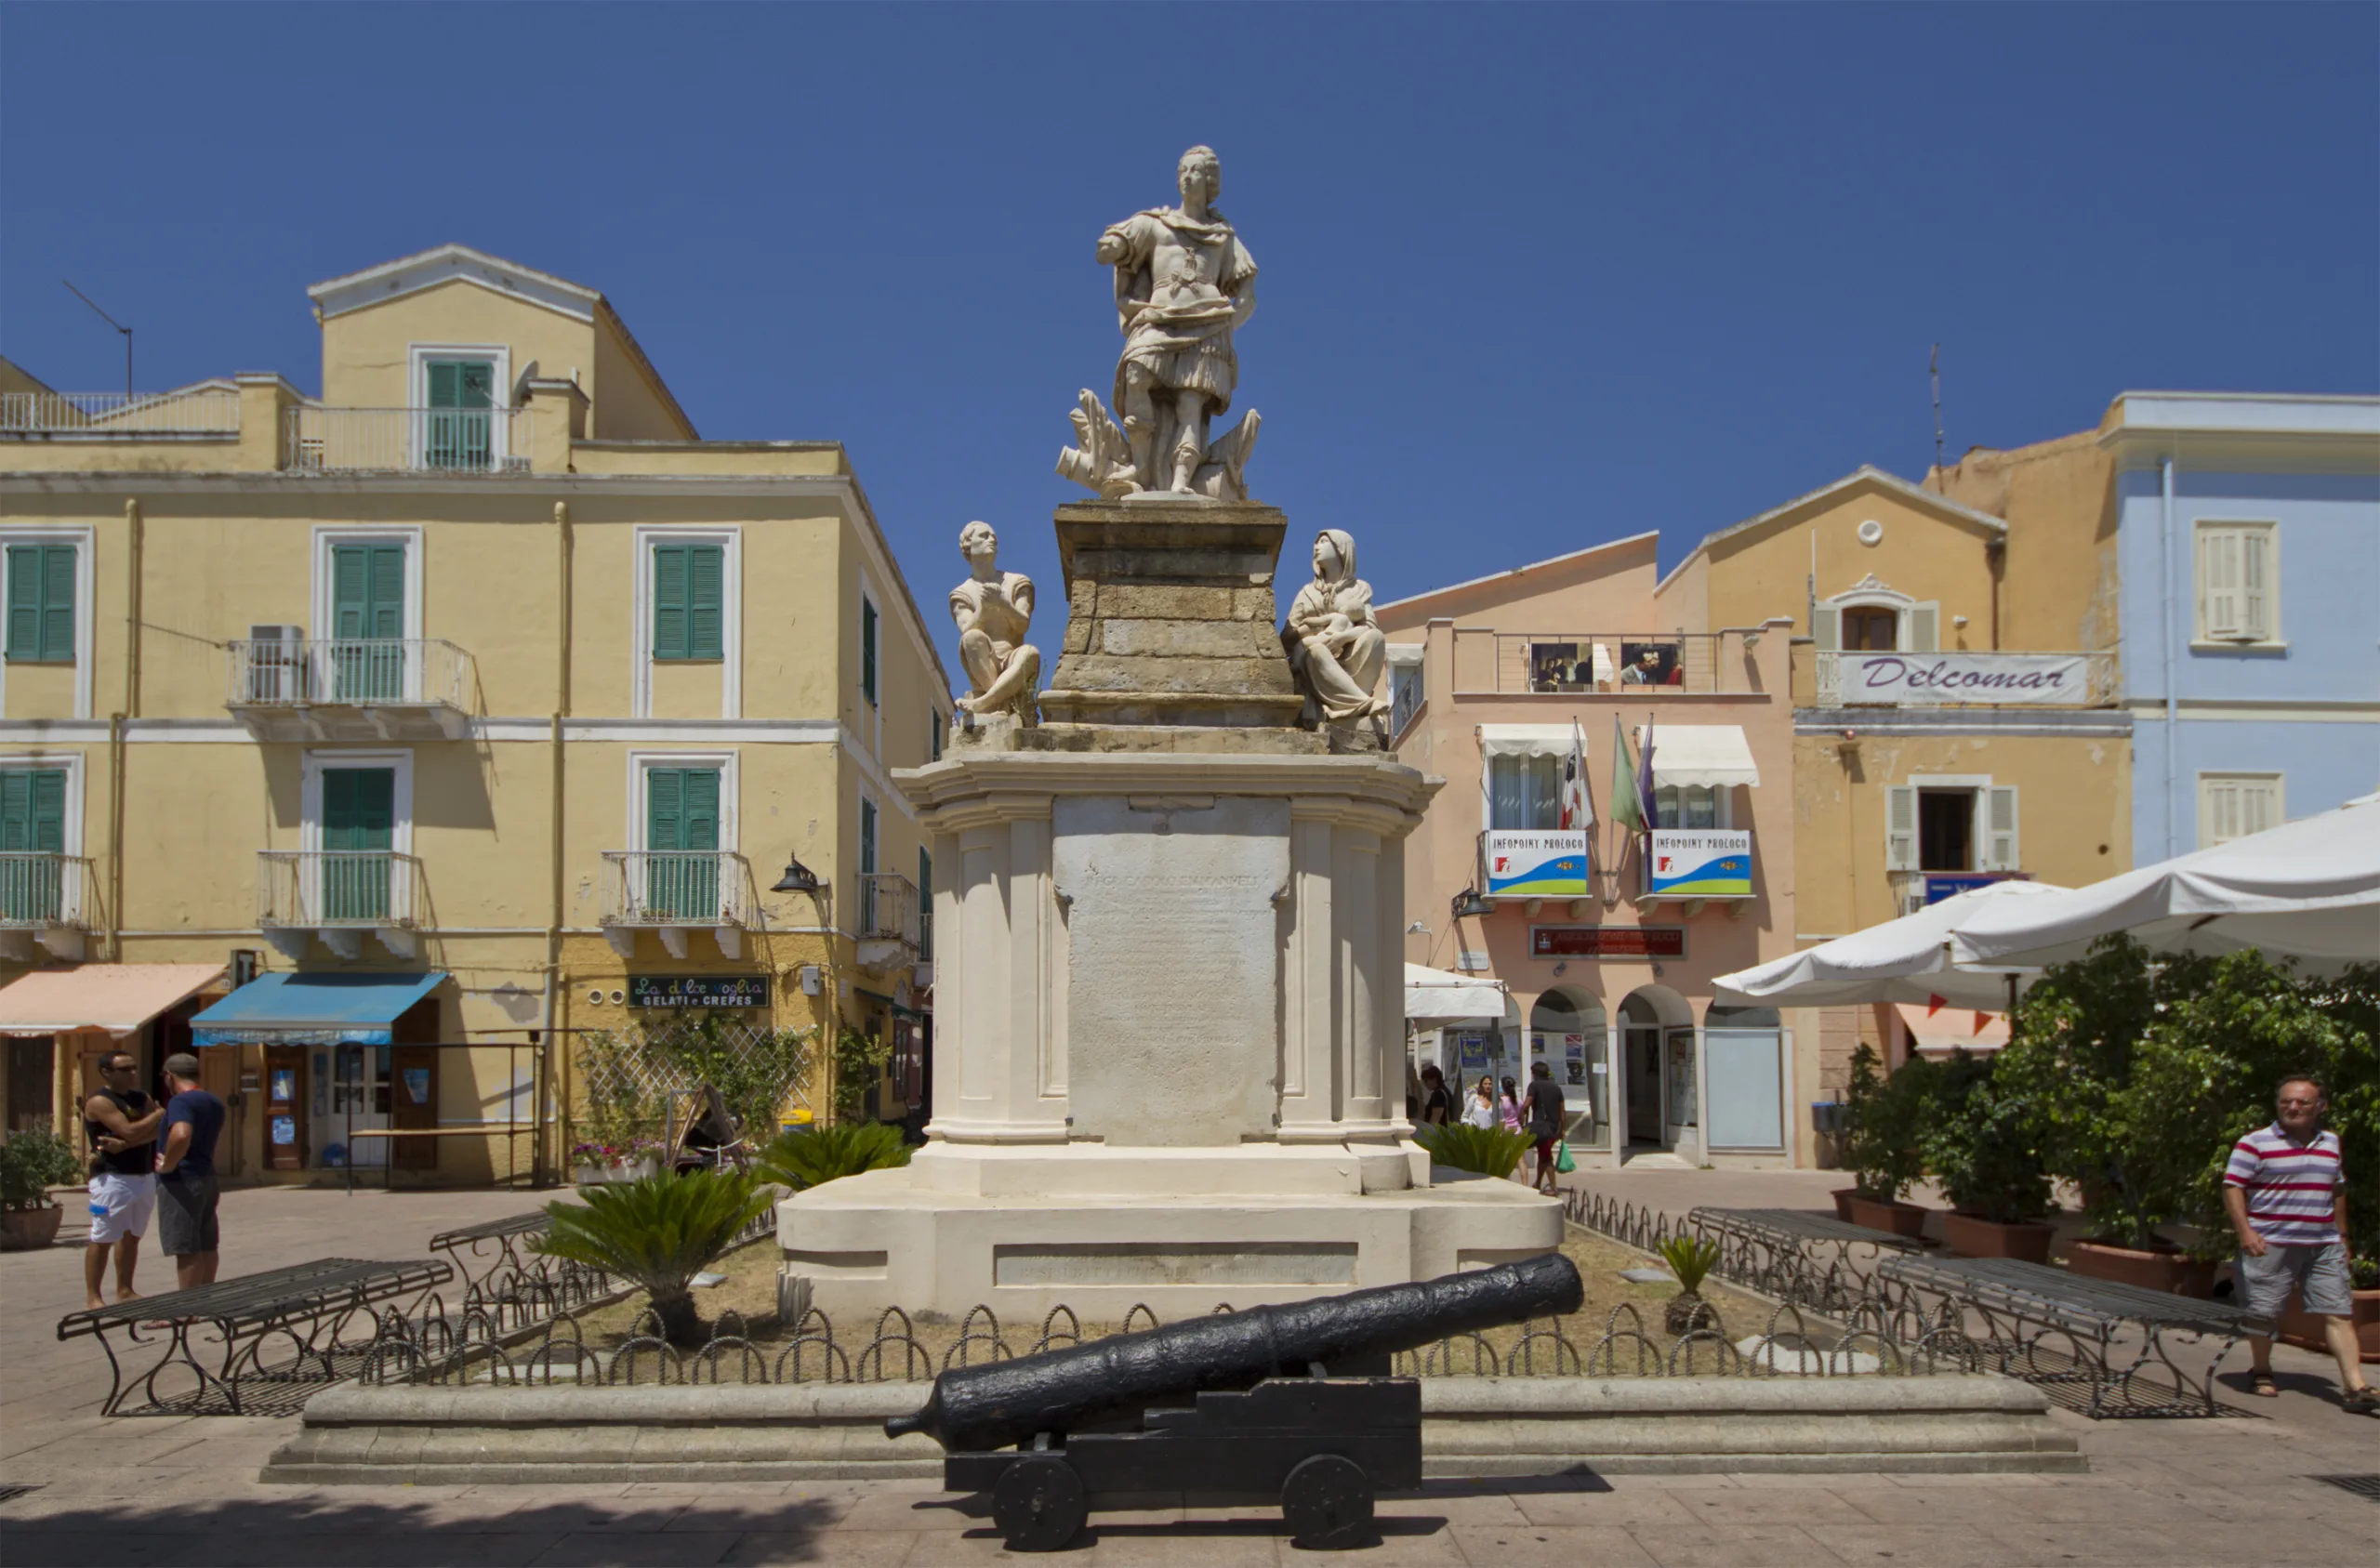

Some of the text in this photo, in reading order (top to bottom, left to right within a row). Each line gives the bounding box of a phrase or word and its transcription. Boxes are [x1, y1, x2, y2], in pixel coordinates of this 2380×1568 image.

[1861, 657, 2065, 689] Delcomar
[1493, 837, 1583, 850] INFOPOINT PROLOCO
[1657, 837, 1747, 849] INFOPOINT PROLOCO
[635, 977, 762, 997] La dolce voglia
[643, 995, 752, 1006] GELATI e CREPES
